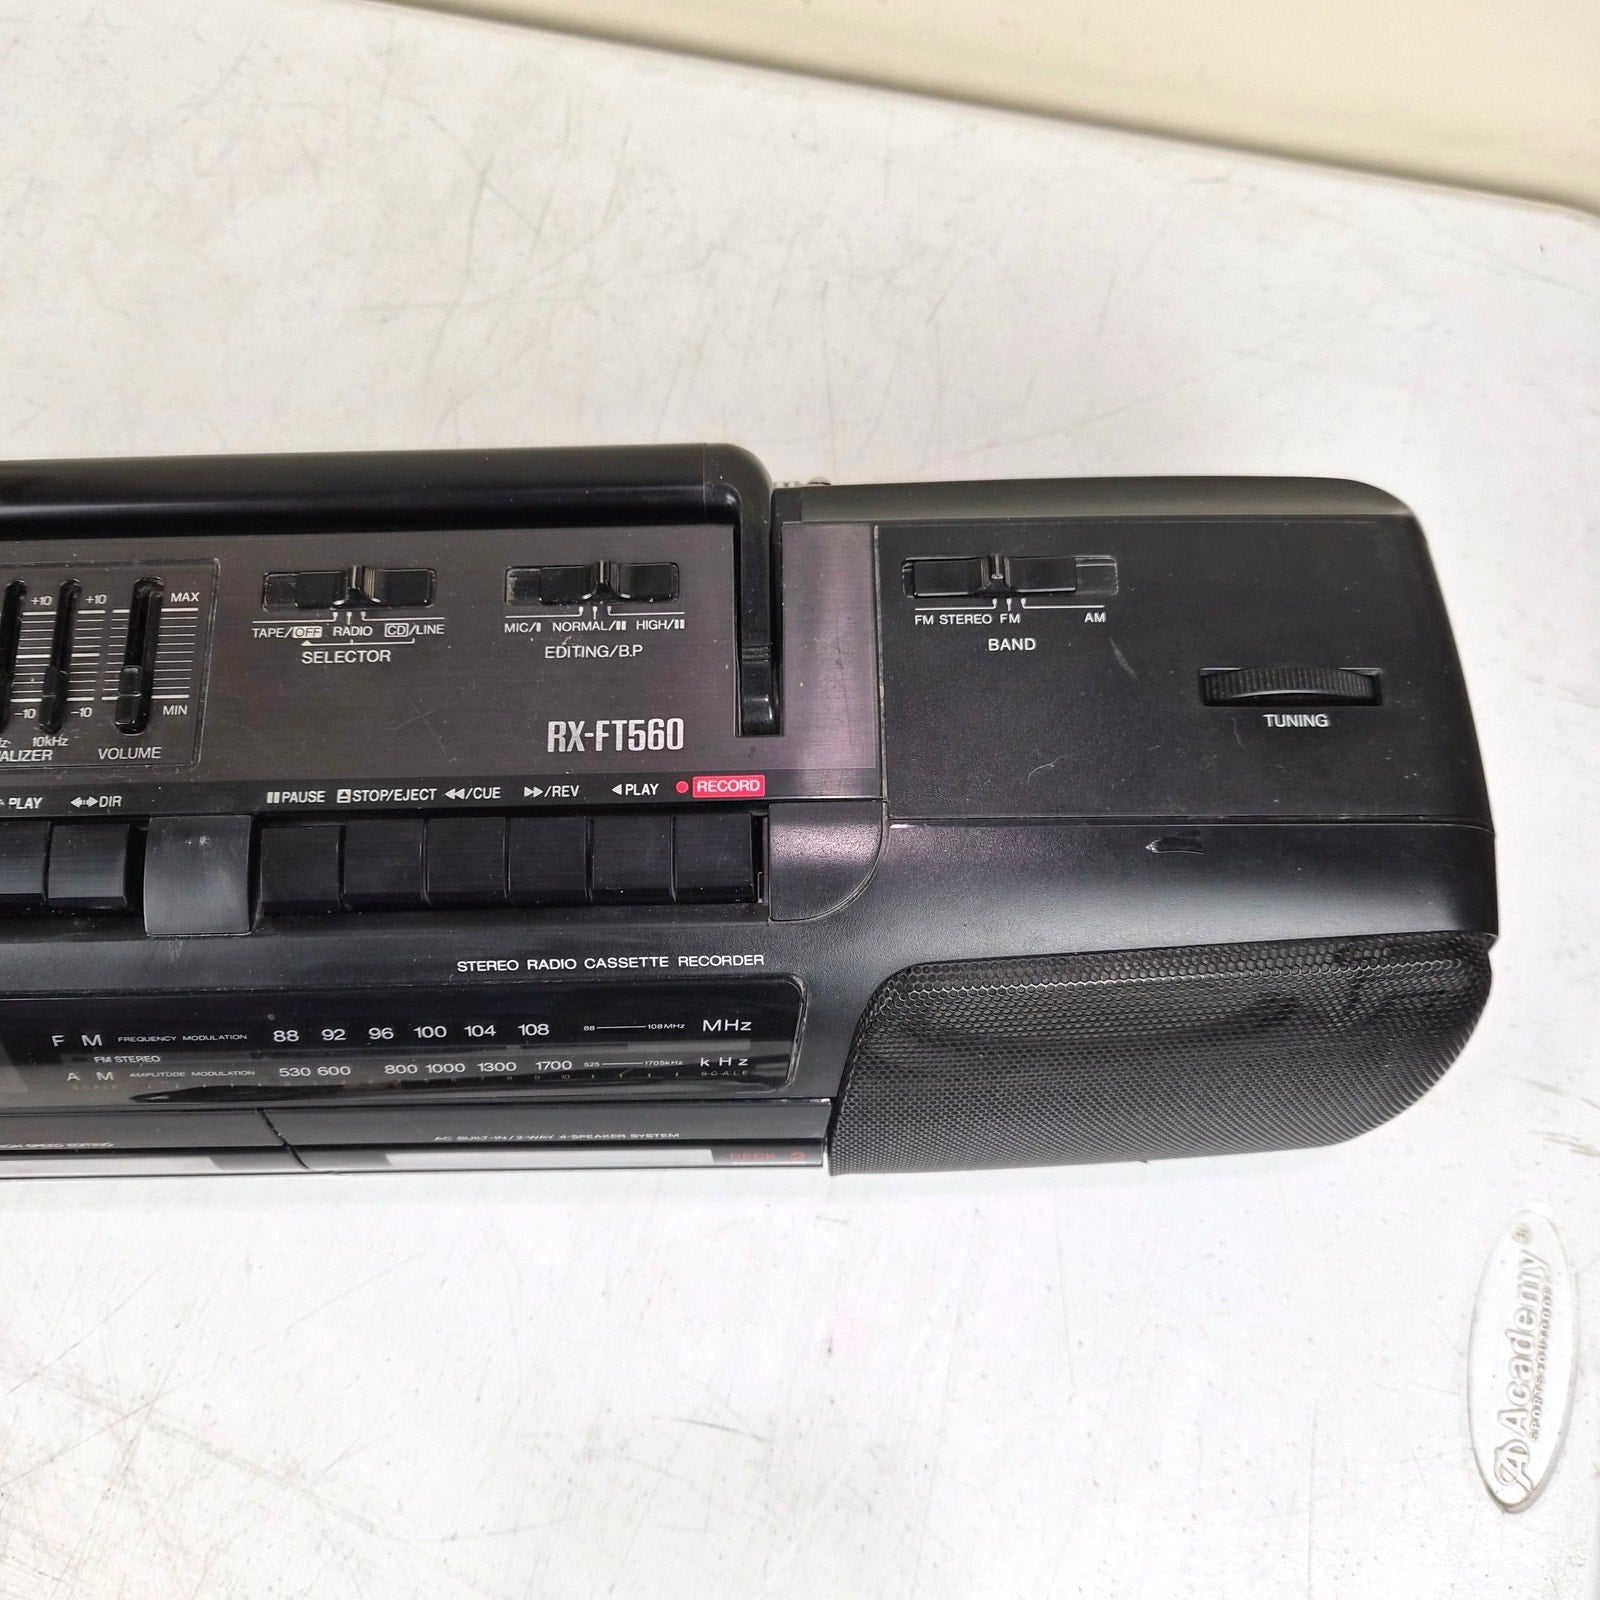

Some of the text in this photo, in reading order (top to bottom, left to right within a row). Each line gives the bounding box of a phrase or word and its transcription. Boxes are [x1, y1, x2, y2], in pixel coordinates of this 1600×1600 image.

[30, 596, 52, 606] +10
[85, 594, 107, 605] +10
[170, 592, 200, 602] MAX
[914, 615, 992, 625] FM STEREO
[1000, 614, 1021, 624] FM
[1084, 612, 1107, 623] AM
[252, 626, 323, 639] TAPE/OFF
[332, 626, 374, 637] RADIO
[384, 623, 445, 638] CD/LINE
[988, 638, 1037, 651] BAND
[301, 650, 391, 664] SELECTOR
[544, 644, 644, 659] EDITING/B.P
[162, 705, 188, 716] MIN
[1263, 713, 1330, 728] TUNING
[32, 735, 69, 747] 10kHz
[547, 718, 685, 752] RX-FT560
[0, 749, 53, 762] ALIZER
[98, 747, 162, 760] VOLUME
[625, 783, 660, 796] PLAY
[696, 779, 762, 793] RECORD
[281, 791, 326, 804] PAUSE
[352, 788, 438, 802] STOP/EJECT
[8, 797, 43, 809] PLAY
[99, 796, 122, 808] DIR
[457, 955, 765, 972] STEREO RADIO CASSETTE RECORDER
[273, 1030, 299, 1042] 88
[321, 1028, 346, 1041] 92
[368, 1027, 394, 1040] 96
[413, 1026, 447, 1038] 100
[463, 1025, 497, 1037] 104
[517, 1023, 550, 1036] 108
[702, 1019, 752, 1032] MHz
[93, 1055, 161, 1064] FM STEREO
[279, 1067, 311, 1077] 530
[317, 1065, 351, 1076] 600
[384, 1064, 418, 1074] 800
[425, 1062, 466, 1073] 1000
[477, 1061, 517, 1072] 1300
[535, 1060, 573, 1070] 1700
[1497, 1249, 1549, 1437] Academy
